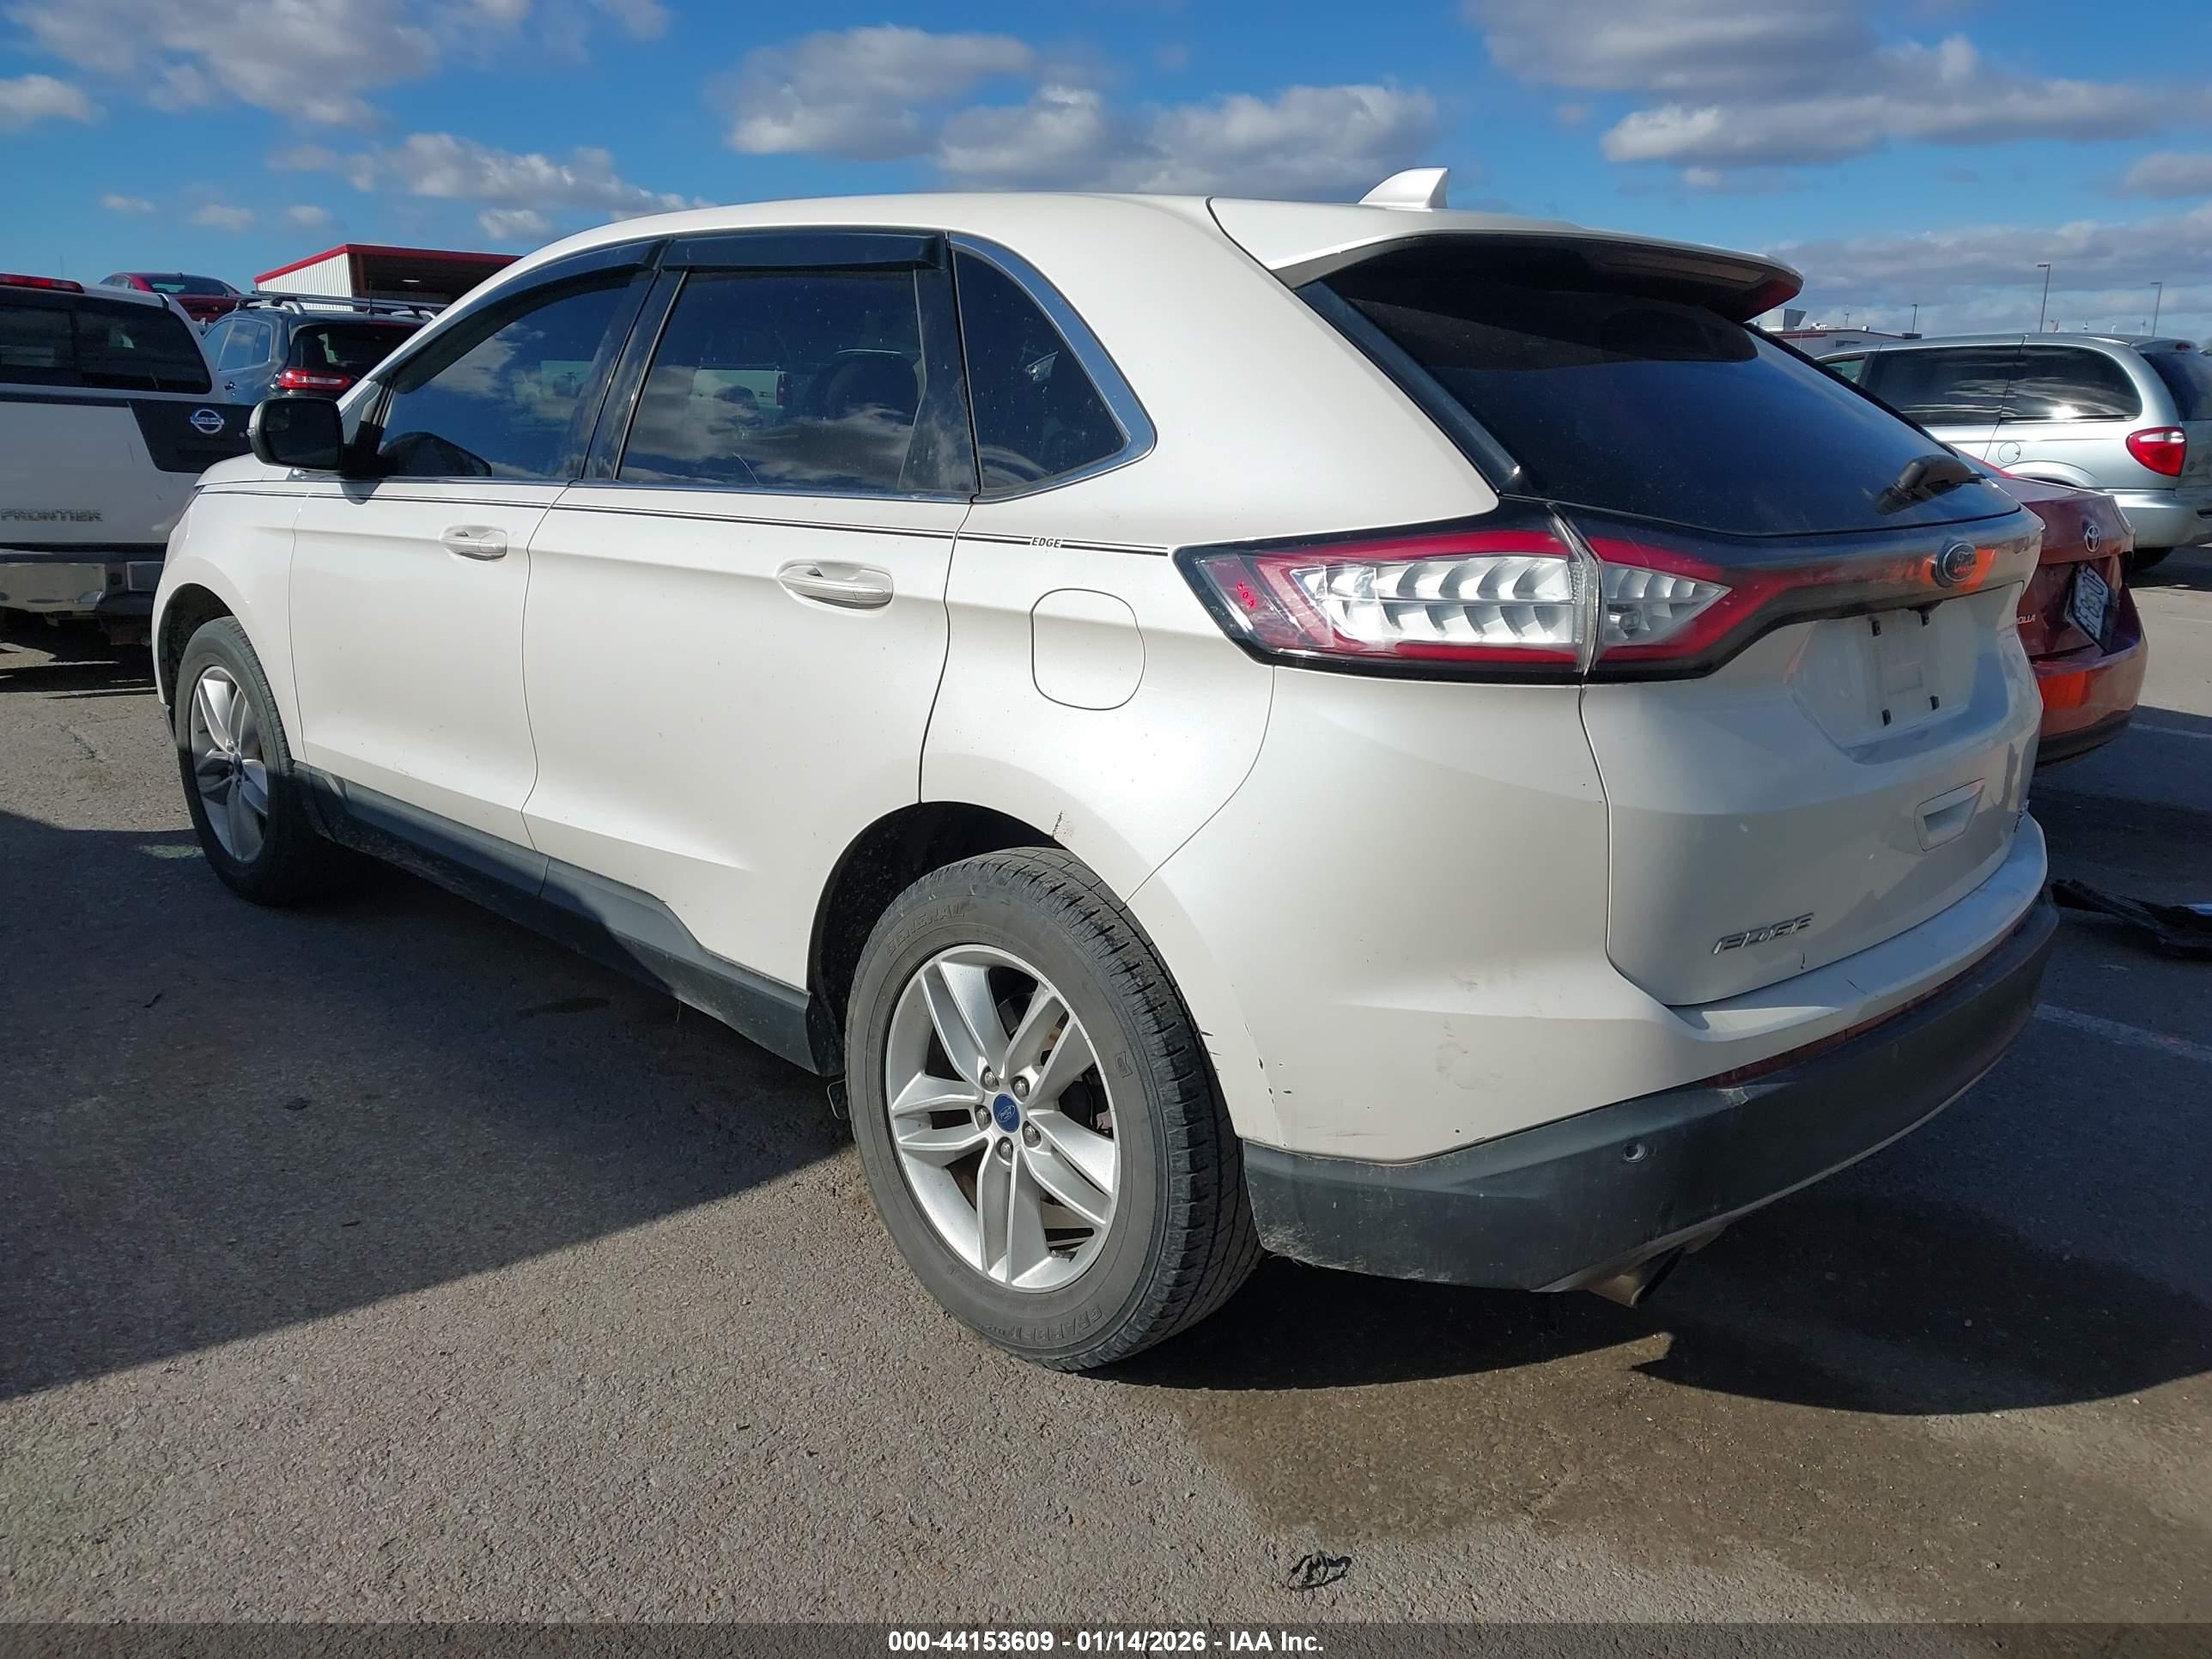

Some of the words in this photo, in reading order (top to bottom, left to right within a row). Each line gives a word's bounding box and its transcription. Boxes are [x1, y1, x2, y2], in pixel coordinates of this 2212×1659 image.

[1, 508, 102, 522] FRONTIER
[1031, 537, 1061, 548] EDGE
[1711, 912, 1814, 955] EDGE
